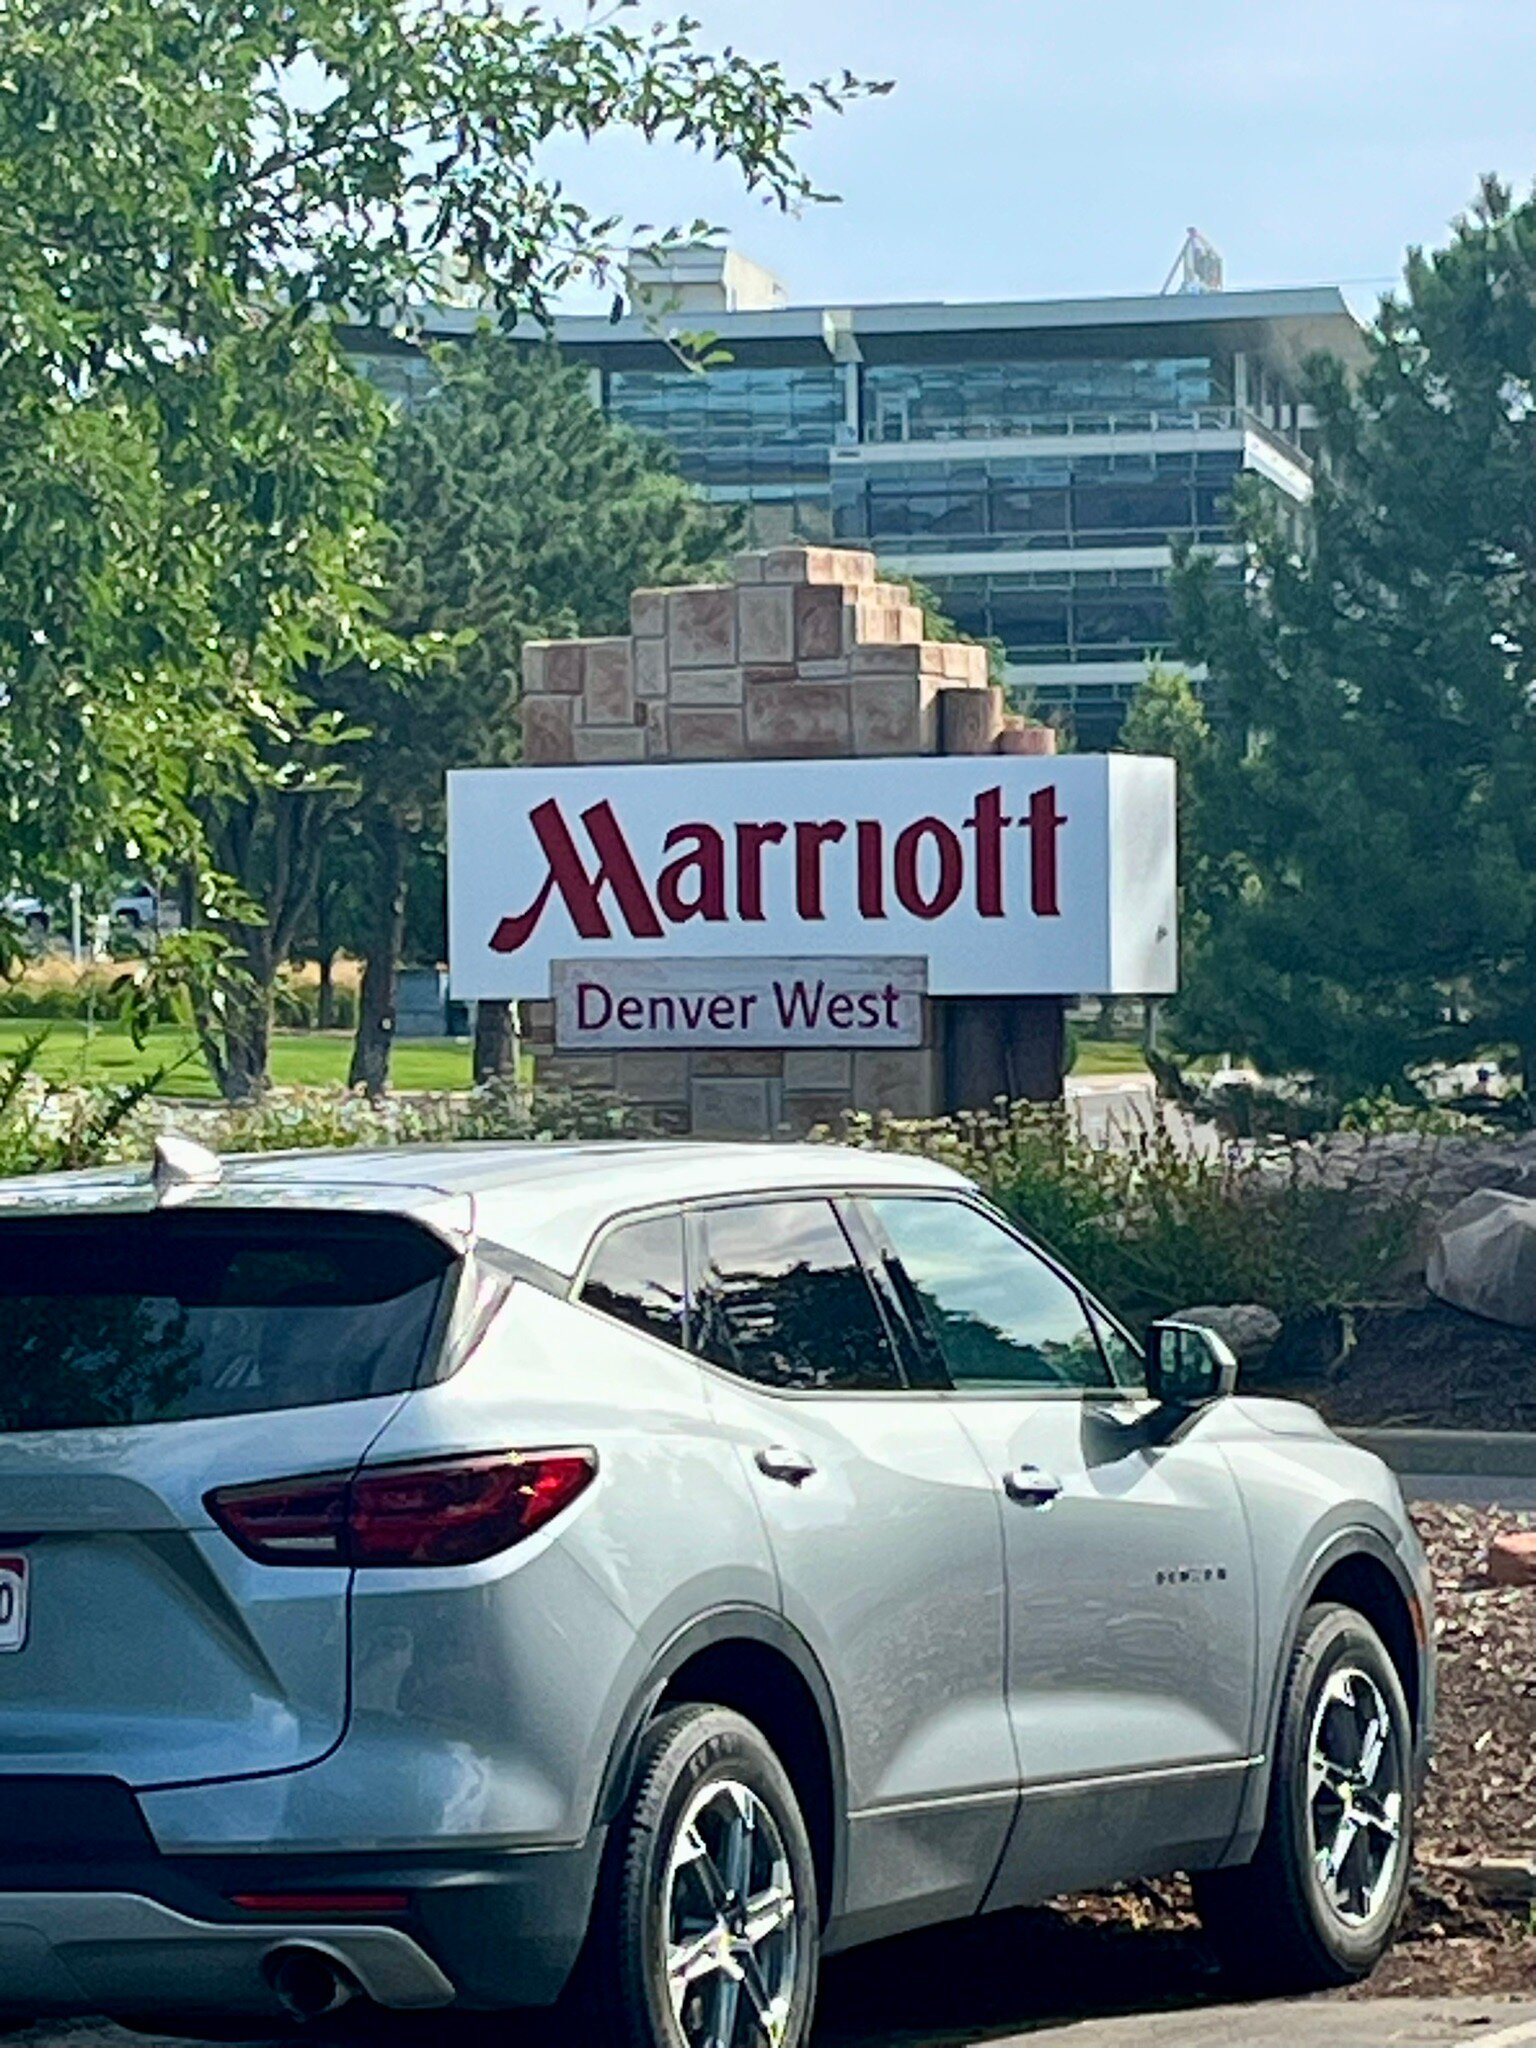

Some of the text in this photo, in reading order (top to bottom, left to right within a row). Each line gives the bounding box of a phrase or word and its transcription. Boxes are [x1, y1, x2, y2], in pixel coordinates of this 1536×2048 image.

[489, 785, 1067, 952] Marriott
[577, 980, 900, 1030] Denver West
